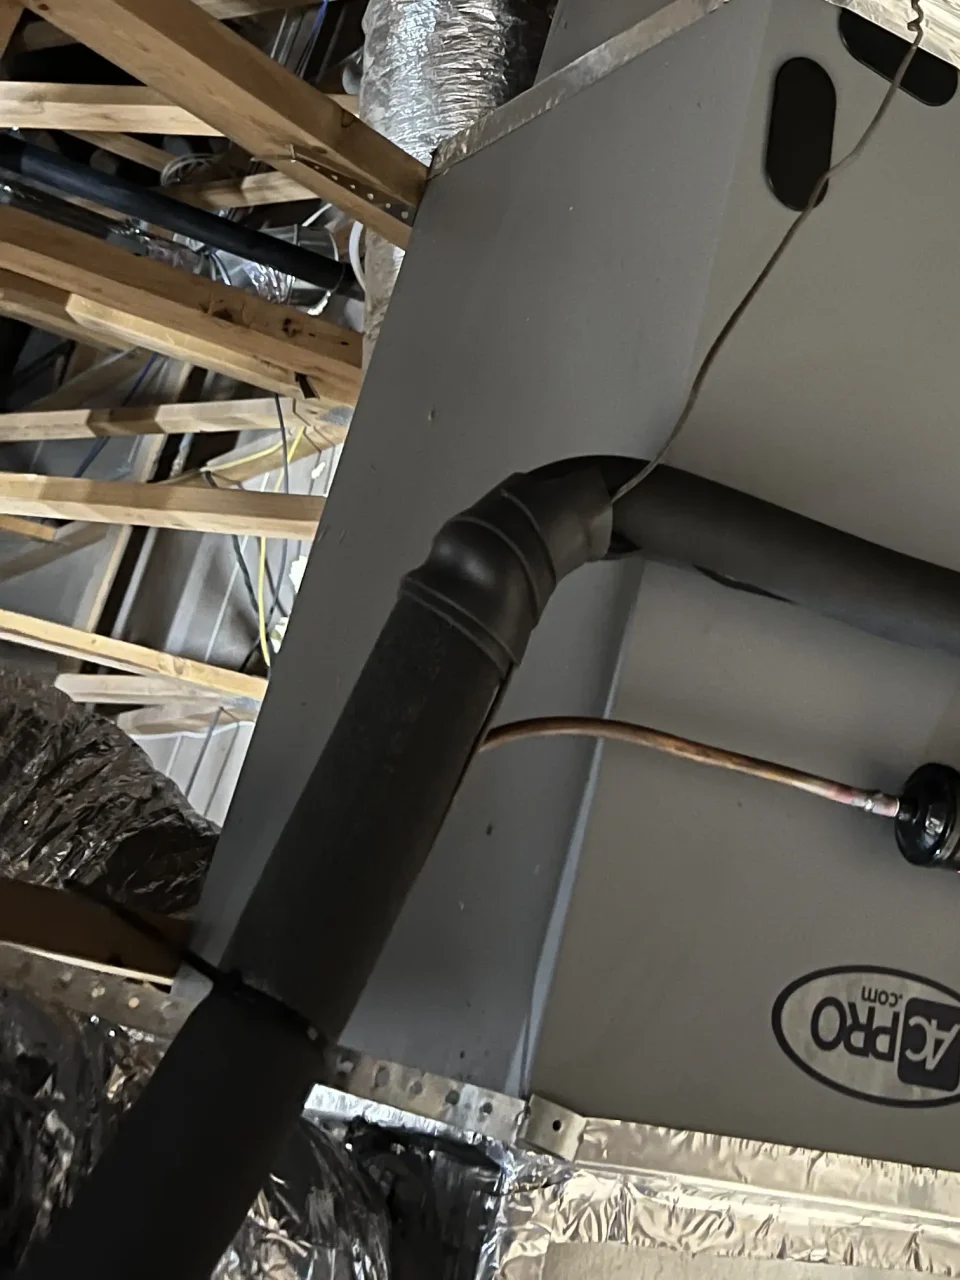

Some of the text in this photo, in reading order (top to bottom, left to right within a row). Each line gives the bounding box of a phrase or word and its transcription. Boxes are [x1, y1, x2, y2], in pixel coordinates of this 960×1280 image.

[860, 985, 903, 1006] .com
[810, 995, 960, 1071] AC PRO
